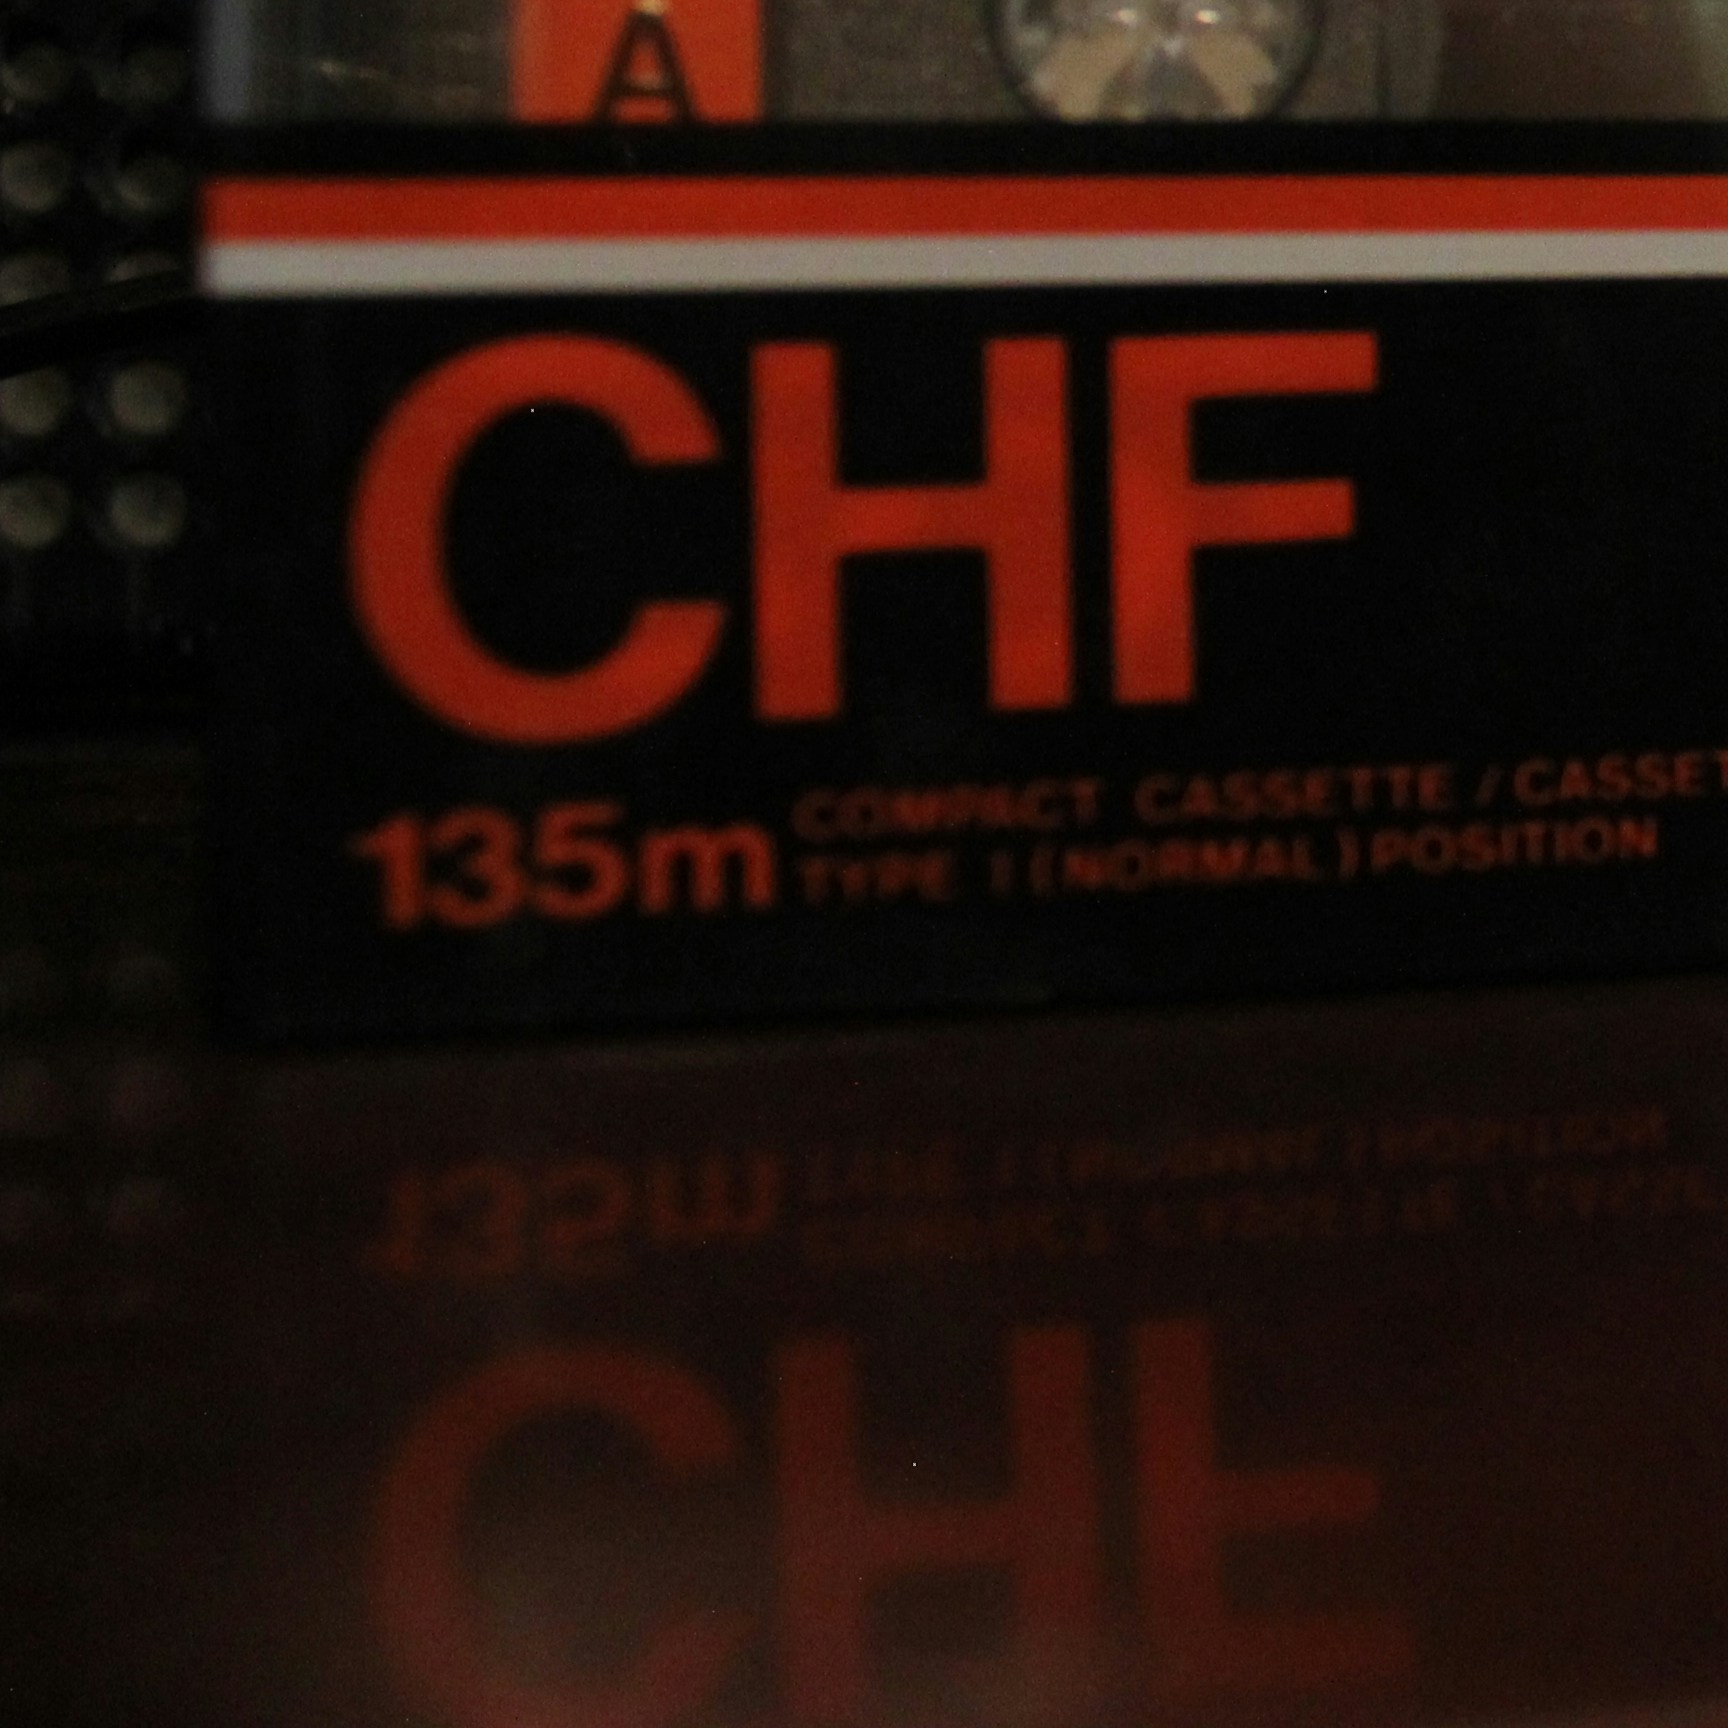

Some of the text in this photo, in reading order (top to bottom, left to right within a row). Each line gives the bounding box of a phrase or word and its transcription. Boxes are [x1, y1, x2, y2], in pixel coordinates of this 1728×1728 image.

[349, 329, 1380, 746] CHF
[353, 795, 779, 932] 135m
[789, 774, 1104, 842] COMPACT
[798, 847, 955, 906] TYPE
[1368, 815, 1660, 881] POSITION
